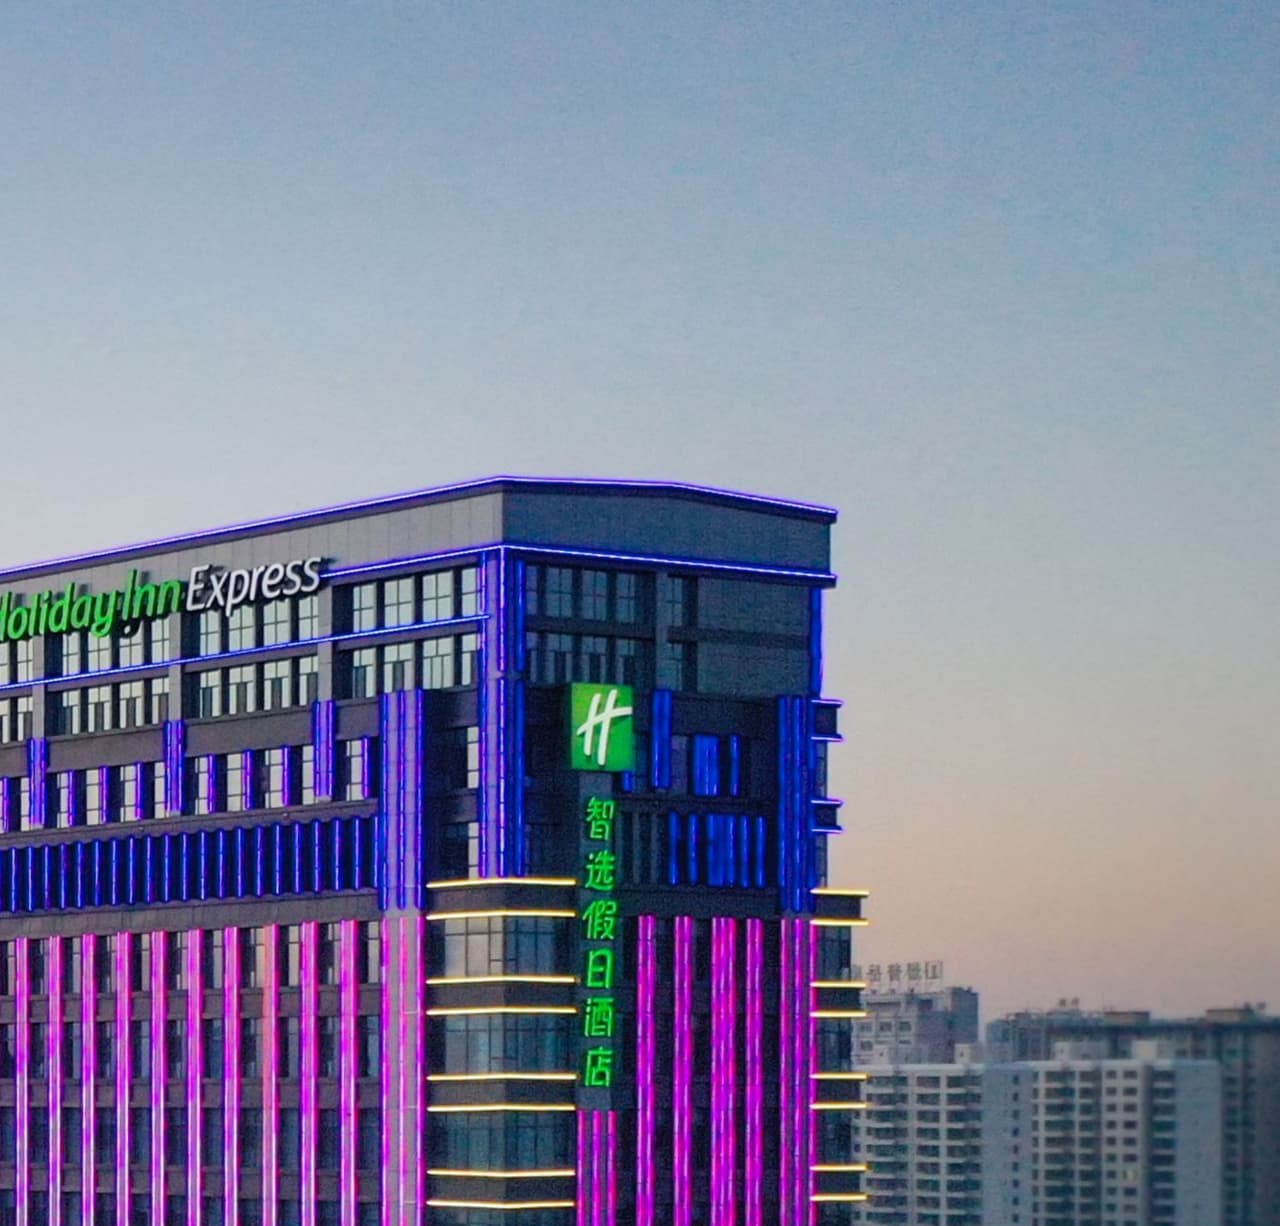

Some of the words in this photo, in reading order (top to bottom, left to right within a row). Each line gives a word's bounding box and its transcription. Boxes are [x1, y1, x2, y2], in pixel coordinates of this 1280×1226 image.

[120, 568, 183, 635] Inn
[185, 557, 322, 617] Express
[581, 796, 617, 1087] 智选假日酒店
